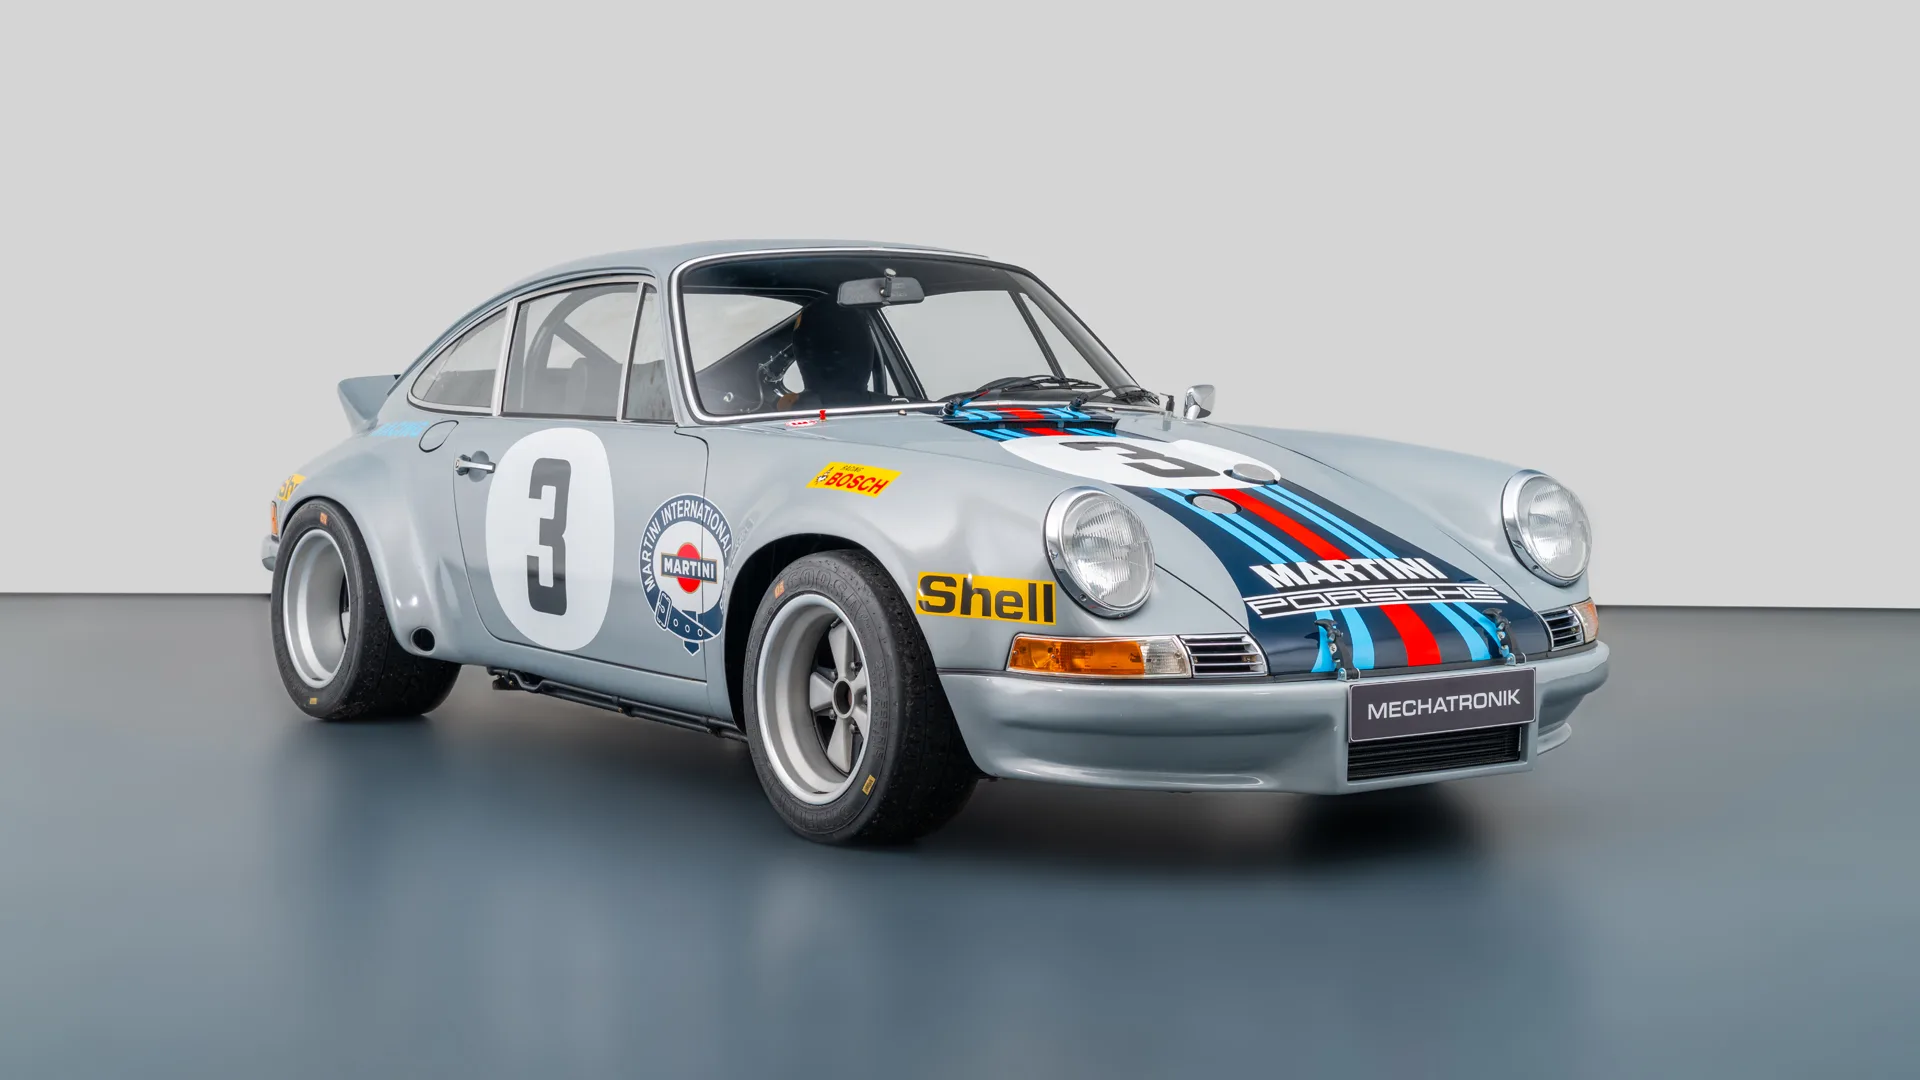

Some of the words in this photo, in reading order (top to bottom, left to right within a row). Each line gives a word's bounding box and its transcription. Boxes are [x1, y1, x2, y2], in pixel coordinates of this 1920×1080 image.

[1059, 441, 1221, 478] 3
[824, 472, 889, 495] BOSCH
[526, 457, 572, 616] 3
[641, 523, 662, 592] MARTINI
[661, 499, 731, 558] INTERNATIONAL
[664, 557, 715, 580] MARTINI
[1249, 557, 1449, 589] MARTINI
[918, 575, 1054, 623] Shell
[1247, 585, 1505, 616] PORSCHE
[1368, 689, 1521, 721] MECHATRONIK
